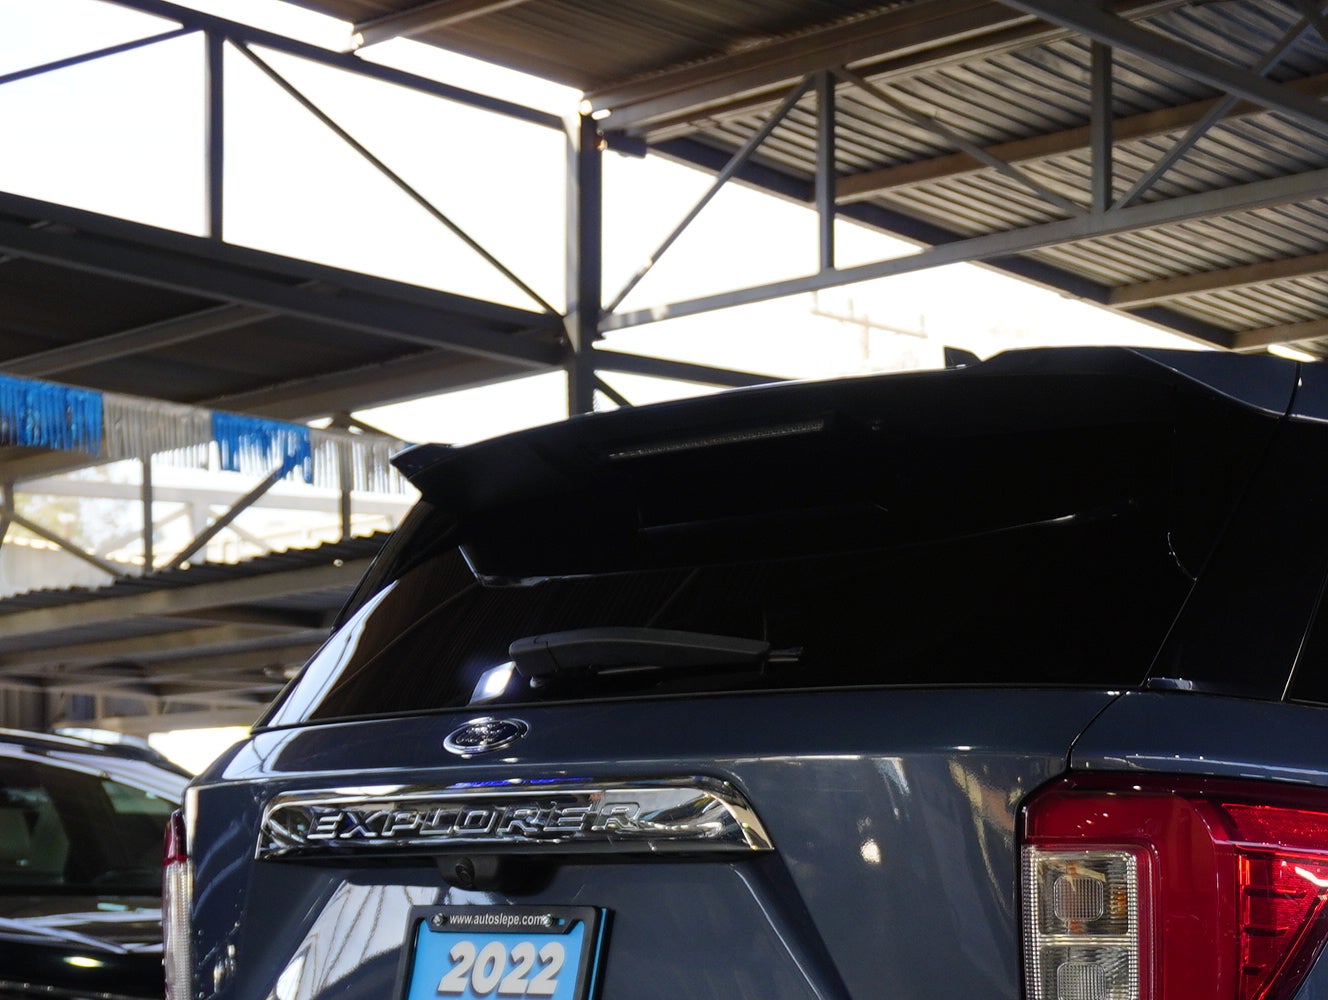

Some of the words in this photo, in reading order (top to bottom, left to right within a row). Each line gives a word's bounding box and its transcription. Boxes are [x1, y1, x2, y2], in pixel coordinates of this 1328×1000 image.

[306, 802, 642, 840] EXPLORER
[449, 912, 545, 928] www.autoslepe.com
[437, 941, 566, 995] 2022
